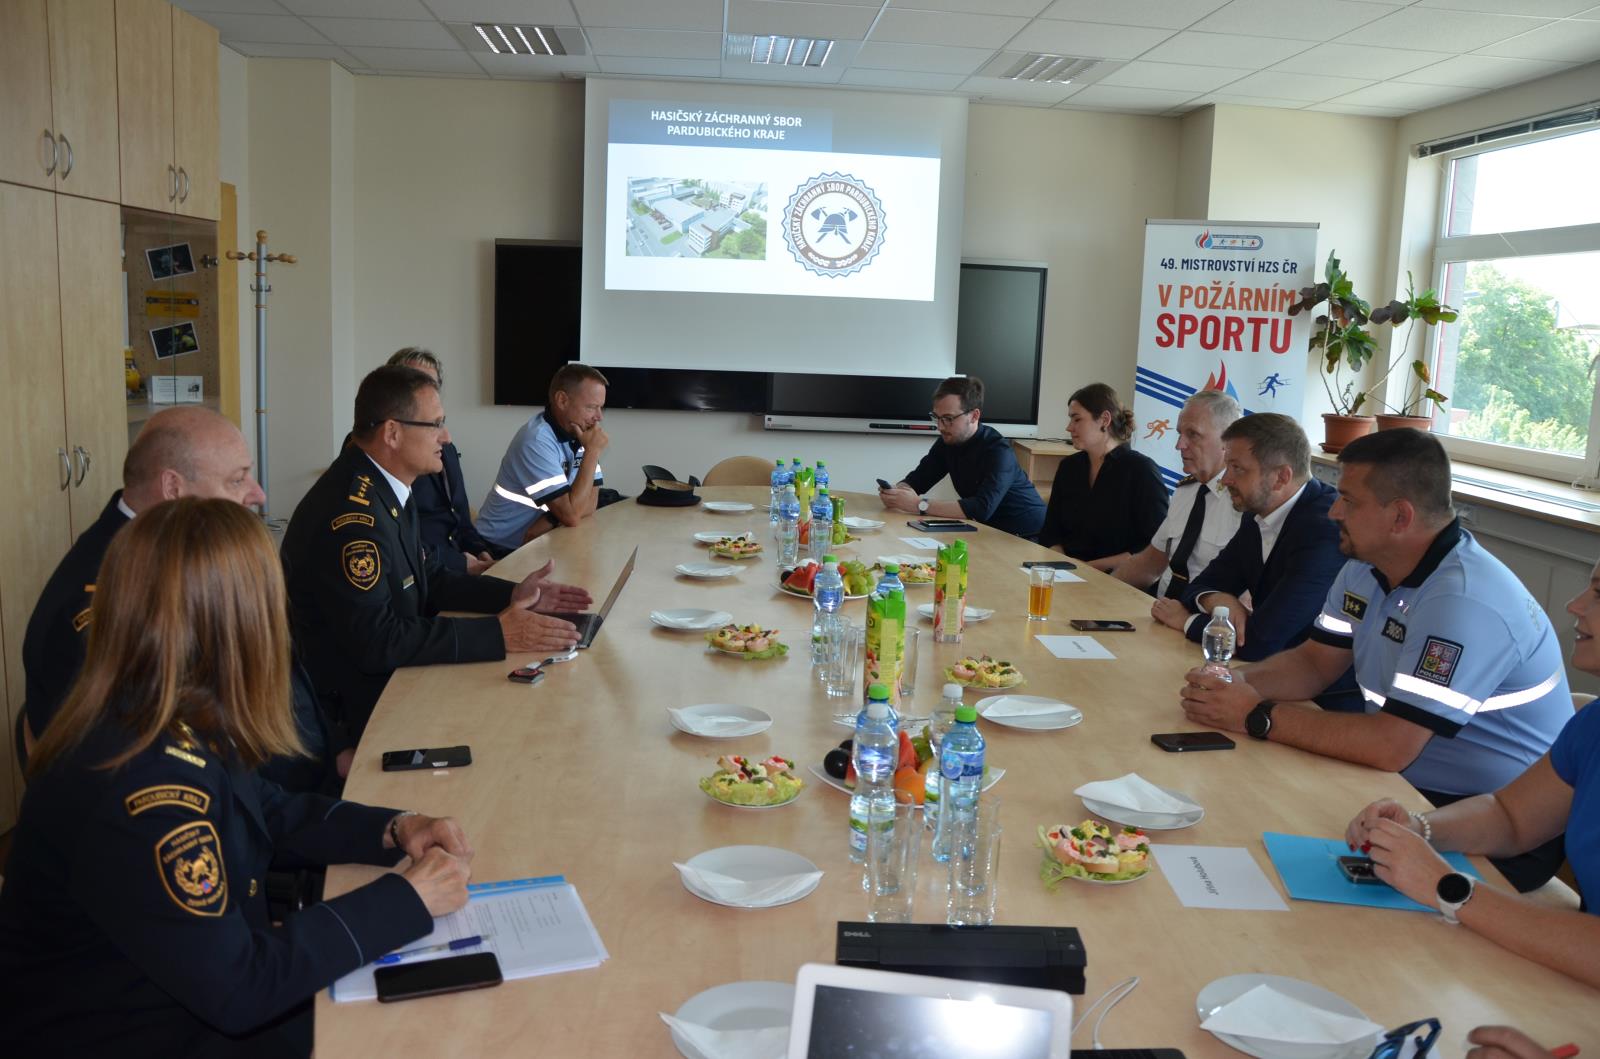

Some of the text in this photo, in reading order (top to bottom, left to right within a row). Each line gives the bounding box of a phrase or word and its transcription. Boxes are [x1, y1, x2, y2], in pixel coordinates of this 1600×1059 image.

[651, 109, 802, 127] HASIČSKÝ ZÁCHRANNÝ SBOR
[667, 125, 785, 140] PARDUBICKÉHO KRAJE
[1160, 257, 1298, 274] 49. MISTROVSTVÍ HZS ČR
[1158, 280, 1297, 313] V POŽÁRNÍM
[1155, 312, 1293, 354] SPORTU
